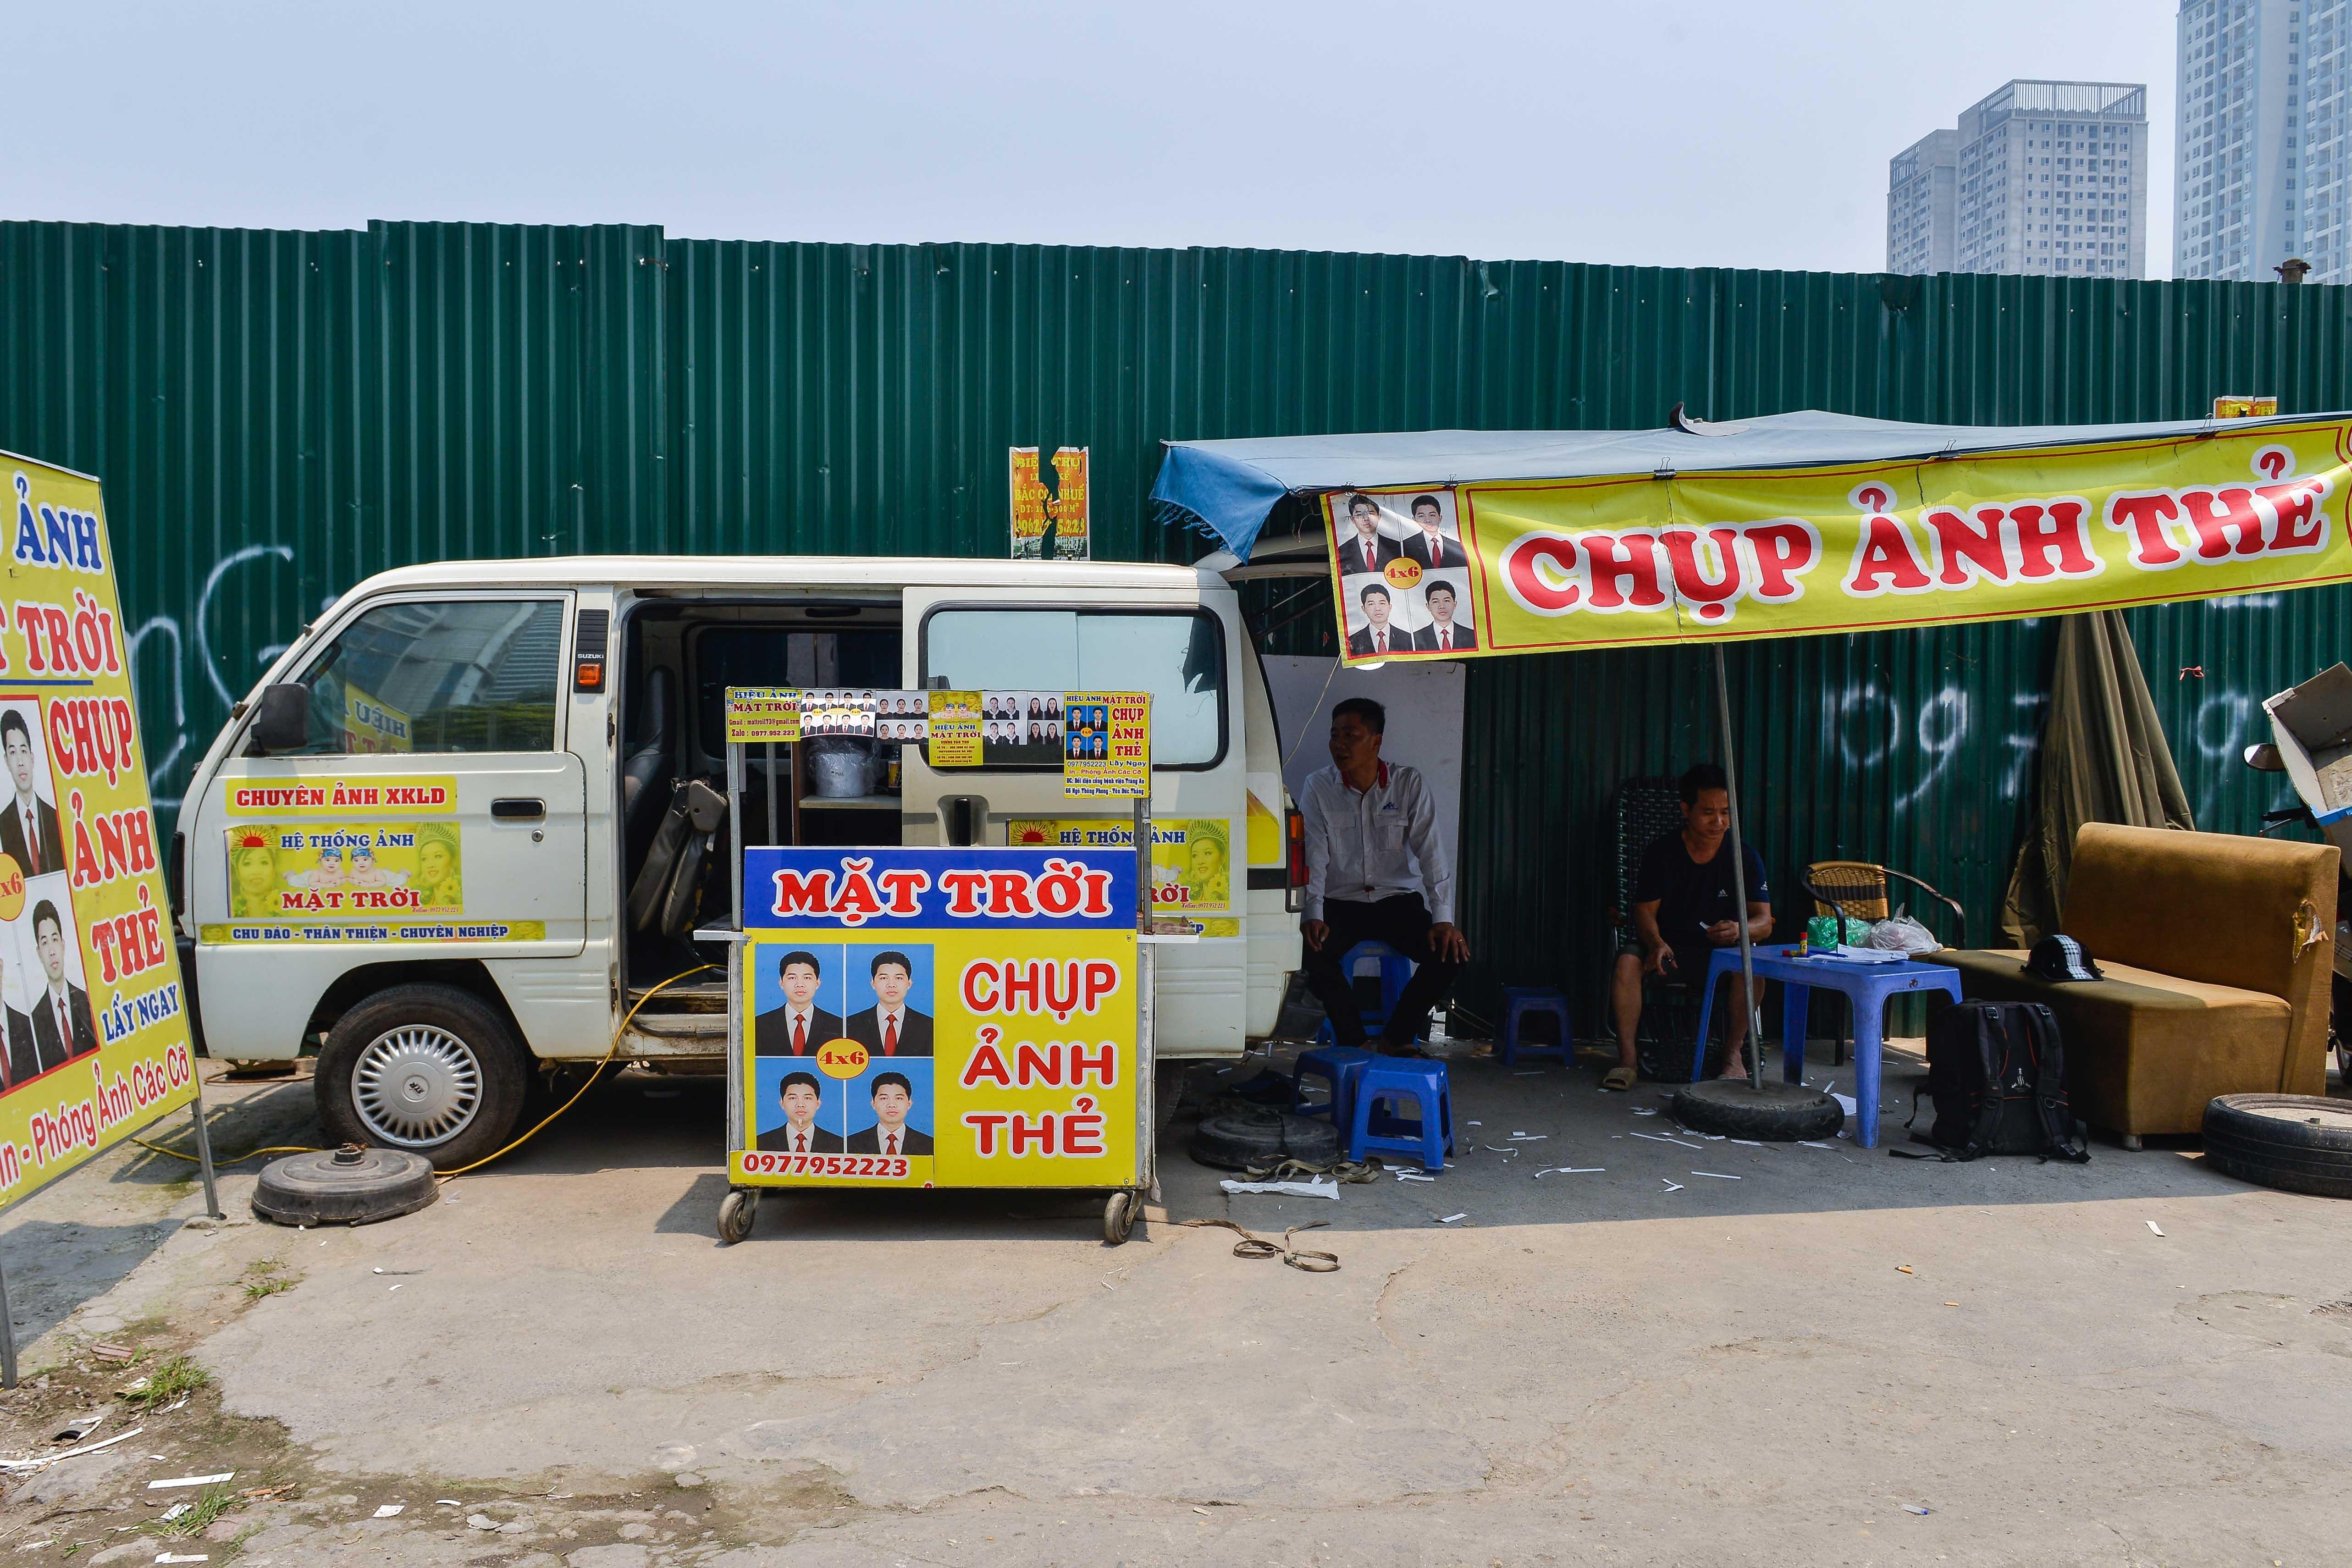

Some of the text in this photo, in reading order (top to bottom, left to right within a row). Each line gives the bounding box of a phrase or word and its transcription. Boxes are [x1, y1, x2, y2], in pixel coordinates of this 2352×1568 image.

[1016, 454, 1038, 469] BIỆ
[1015, 483, 1035, 501] BẮC
[1020, 505, 1033, 513] DT:
[15, 476, 103, 570] ẢNH
[1507, 451, 2324, 620] CHỤP ẢNH THẺ
[1385, 565, 1420, 580] 4x6
[17, 591, 120, 674] TRỜI
[734, 689, 797, 701] HIỆU ẢNH
[1066, 693, 1146, 706] HIỆU ẢNH MẶT TRỜI
[734, 700, 797, 713] MẶT TRỜI
[1112, 707, 1144, 723] CHỤP
[931, 731, 953, 740] MẶT
[1111, 723, 1144, 739] ẢNH
[50, 700, 133, 786] CHỤP
[1115, 741, 1142, 756] THẺ
[236, 782, 446, 806] CHUYÊN ẢNH XKLD
[72, 792, 156, 888] ẢNH
[281, 828, 415, 849] HỆ THỐNG ẢNH
[1060, 825, 1186, 845] HỆ THỐN ẢNH
[0, 872, 22, 897] x6
[777, 860, 1110, 923] MẶT TRỜI
[1152, 883, 1189, 903] ỜI
[282, 888, 422, 913] MẶT TRỜI
[92, 885, 166, 983] THẺ
[232, 928, 260, 940] CHU
[264, 925, 291, 939] ĐÁO
[303, 924, 342, 939] THÂN
[345, 924, 387, 942] THIỆN
[400, 924, 454, 938] CHUYÊN
[458, 923, 508, 940] NGHIỆP
[964, 962, 1116, 1021] CHỤP
[102, 985, 179, 1042] LẤY NGAY
[819, 1051, 866, 1066] 4x6
[962, 1027, 1115, 1087] ẢNH
[32, 1099, 97, 1167] Phóng
[94, 1060, 133, 1131] Ảnh
[133, 1062, 167, 1105] Các
[167, 1044, 190, 1088] Cỡ
[965, 1097, 1102, 1154] THẺ
[743, 1154, 908, 1177] 0977952223
